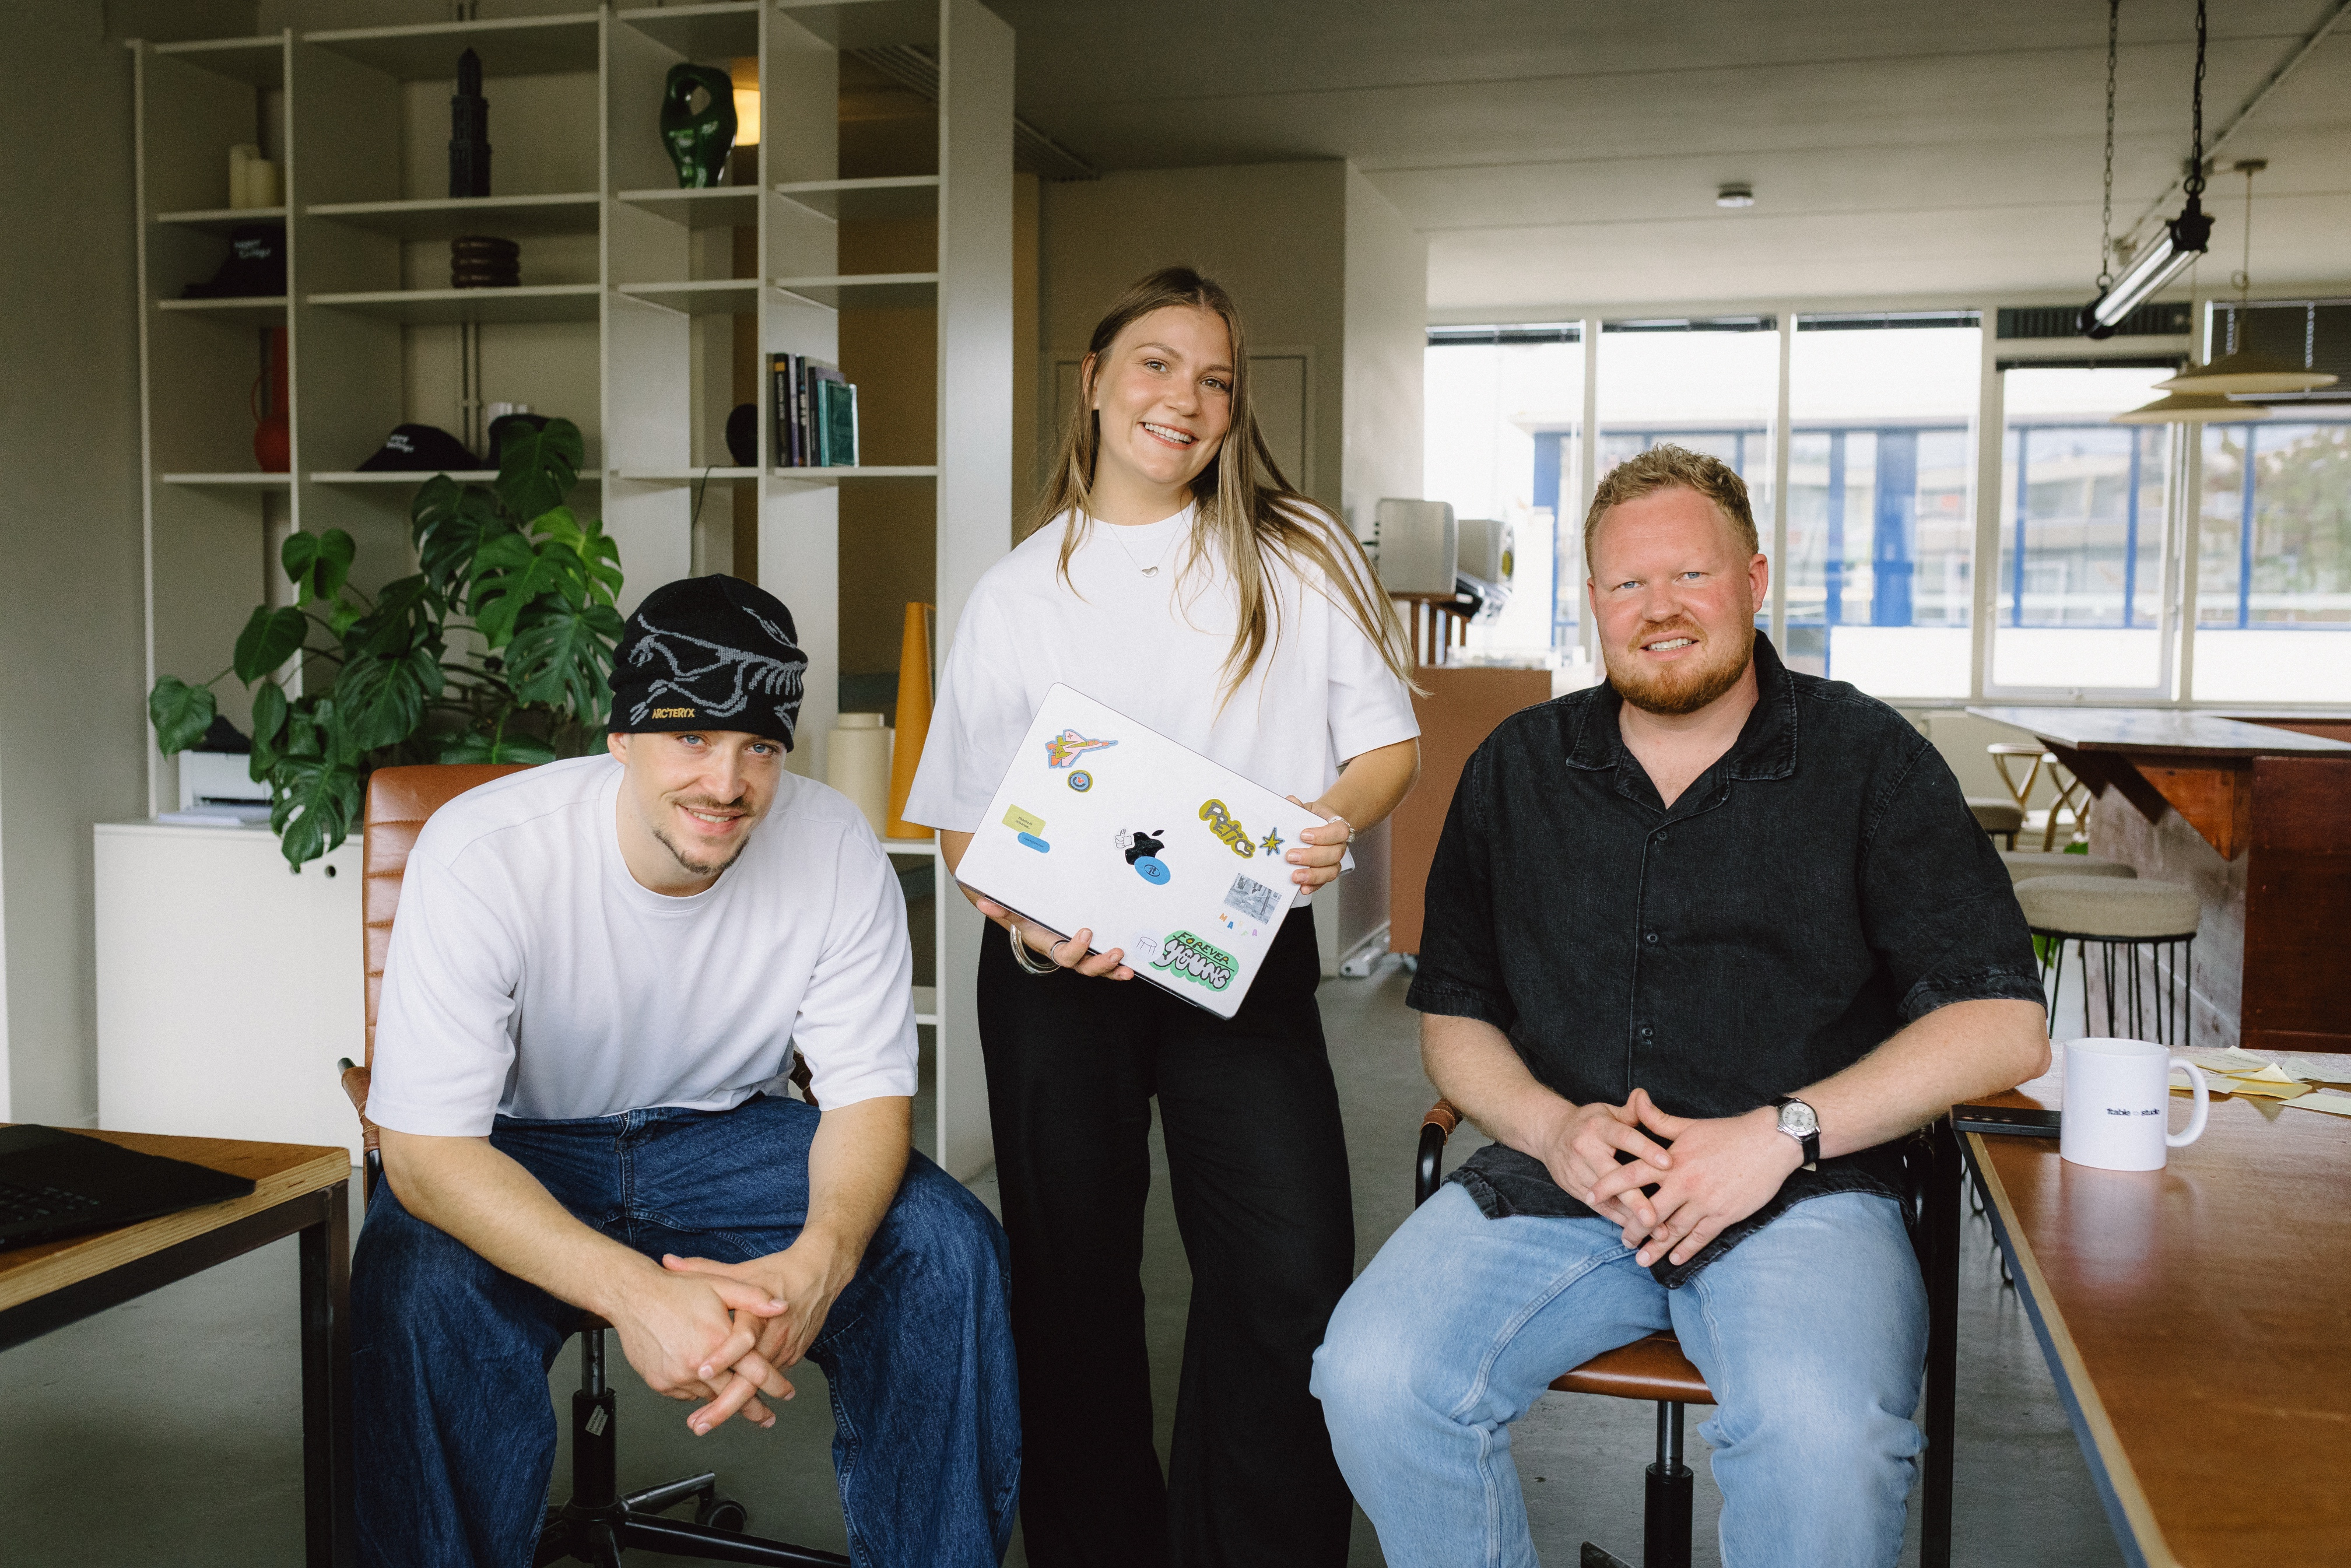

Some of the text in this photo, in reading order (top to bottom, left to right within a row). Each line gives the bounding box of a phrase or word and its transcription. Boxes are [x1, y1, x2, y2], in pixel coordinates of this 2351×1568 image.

[652, 707, 695, 719] ARC'TERYX
[1018, 816, 1029, 825] Thanks
[1177, 932, 1229, 965] FOREVER
